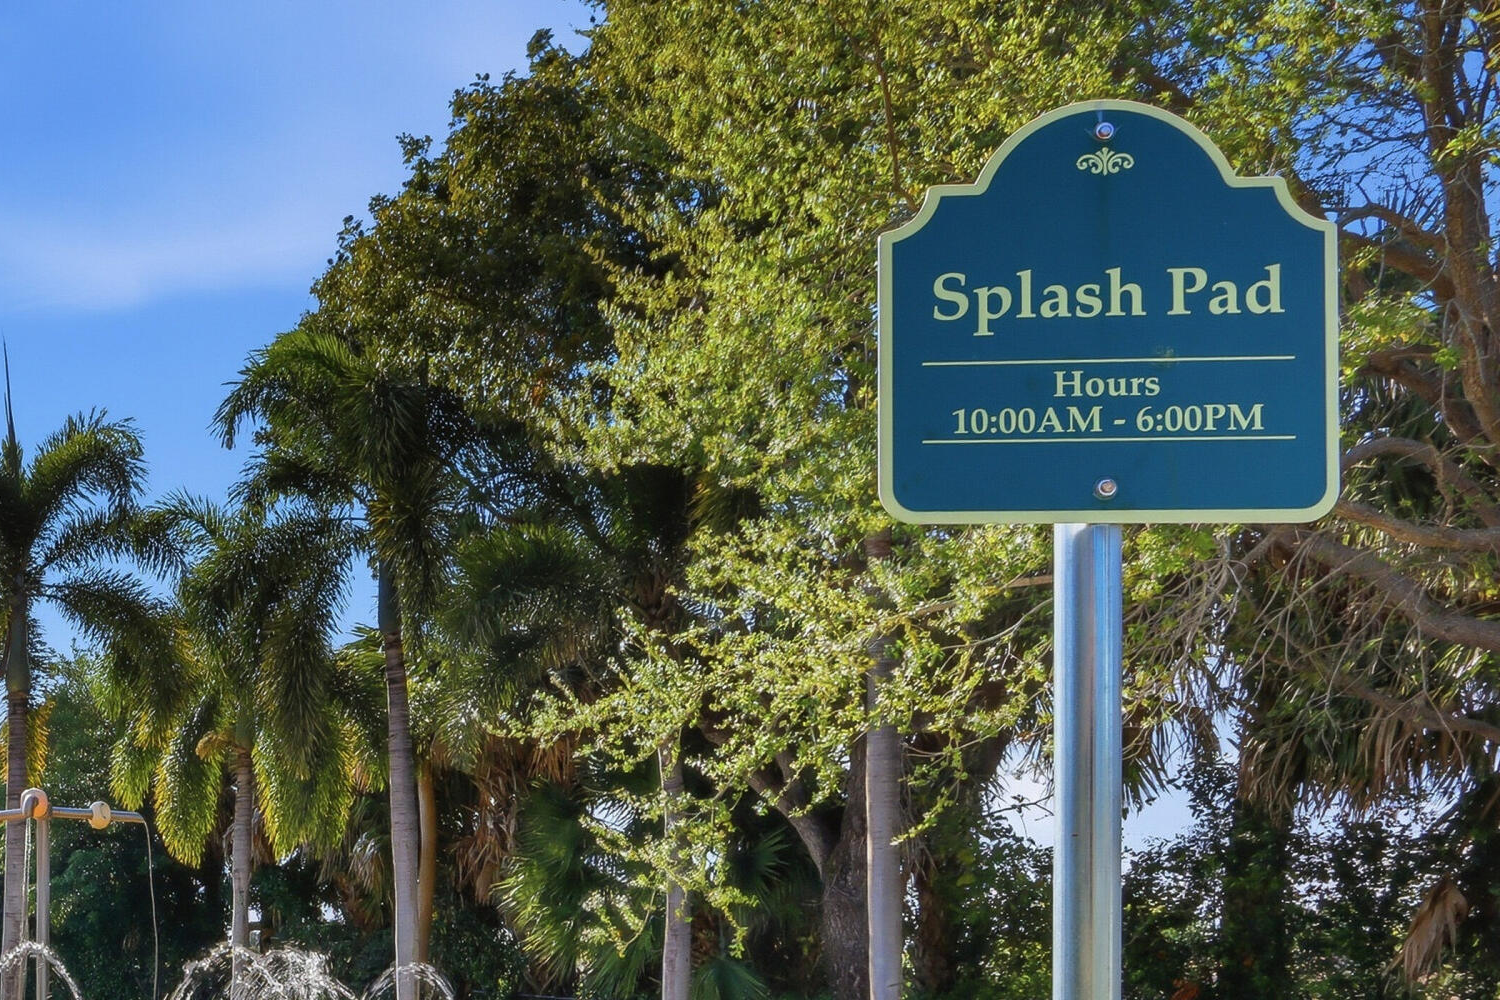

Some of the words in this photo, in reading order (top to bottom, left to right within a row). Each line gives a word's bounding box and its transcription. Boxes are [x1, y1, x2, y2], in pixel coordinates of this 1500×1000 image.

[934, 268, 1146, 335] Splash
[1167, 264, 1285, 314] Pad
[1054, 371, 1159, 396] Hours
[953, 407, 1102, 433] 10:00AM
[1137, 404, 1263, 431] 6:00PM
